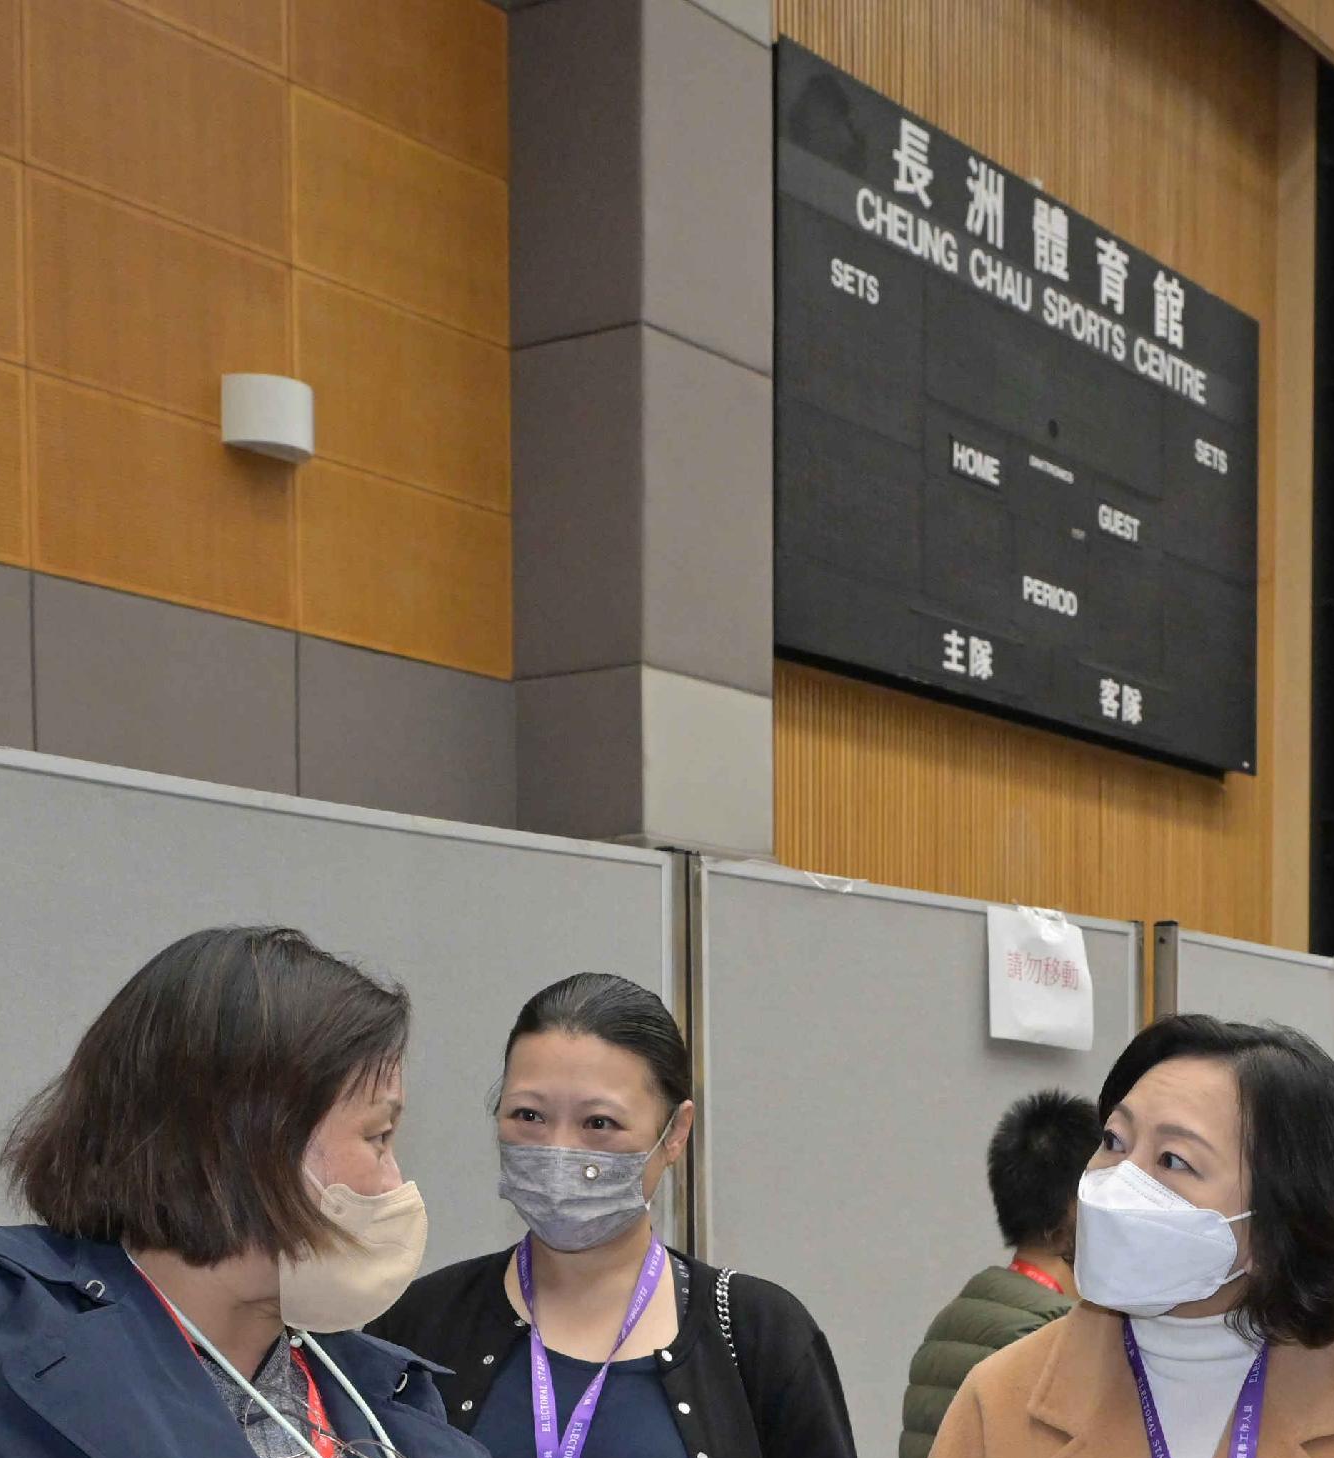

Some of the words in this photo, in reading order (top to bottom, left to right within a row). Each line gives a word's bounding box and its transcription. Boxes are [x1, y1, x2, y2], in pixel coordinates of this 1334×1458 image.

[892, 117, 1185, 349] 長洲體育館
[830, 257, 880, 305] SETS
[856, 187, 959, 274] CHEUNG
[969, 248, 1033, 312] CHAU
[1043, 287, 1126, 361] SPORTS
[1134, 337, 1208, 406] CENTRE
[952, 440, 1001, 487] HOME
[1194, 438, 1229, 475] SETS
[1097, 502, 1141, 542] GUEST
[1022, 574, 1079, 618] PERIOD
[942, 629, 994, 681] 主隊
[1099, 677, 1143, 725] 客隊
[1007, 951, 1080, 991] 請勿移動
[539, 1387, 551, 1433] ELECTORAL
[1136, 1376, 1156, 1437] ELECTORAL
